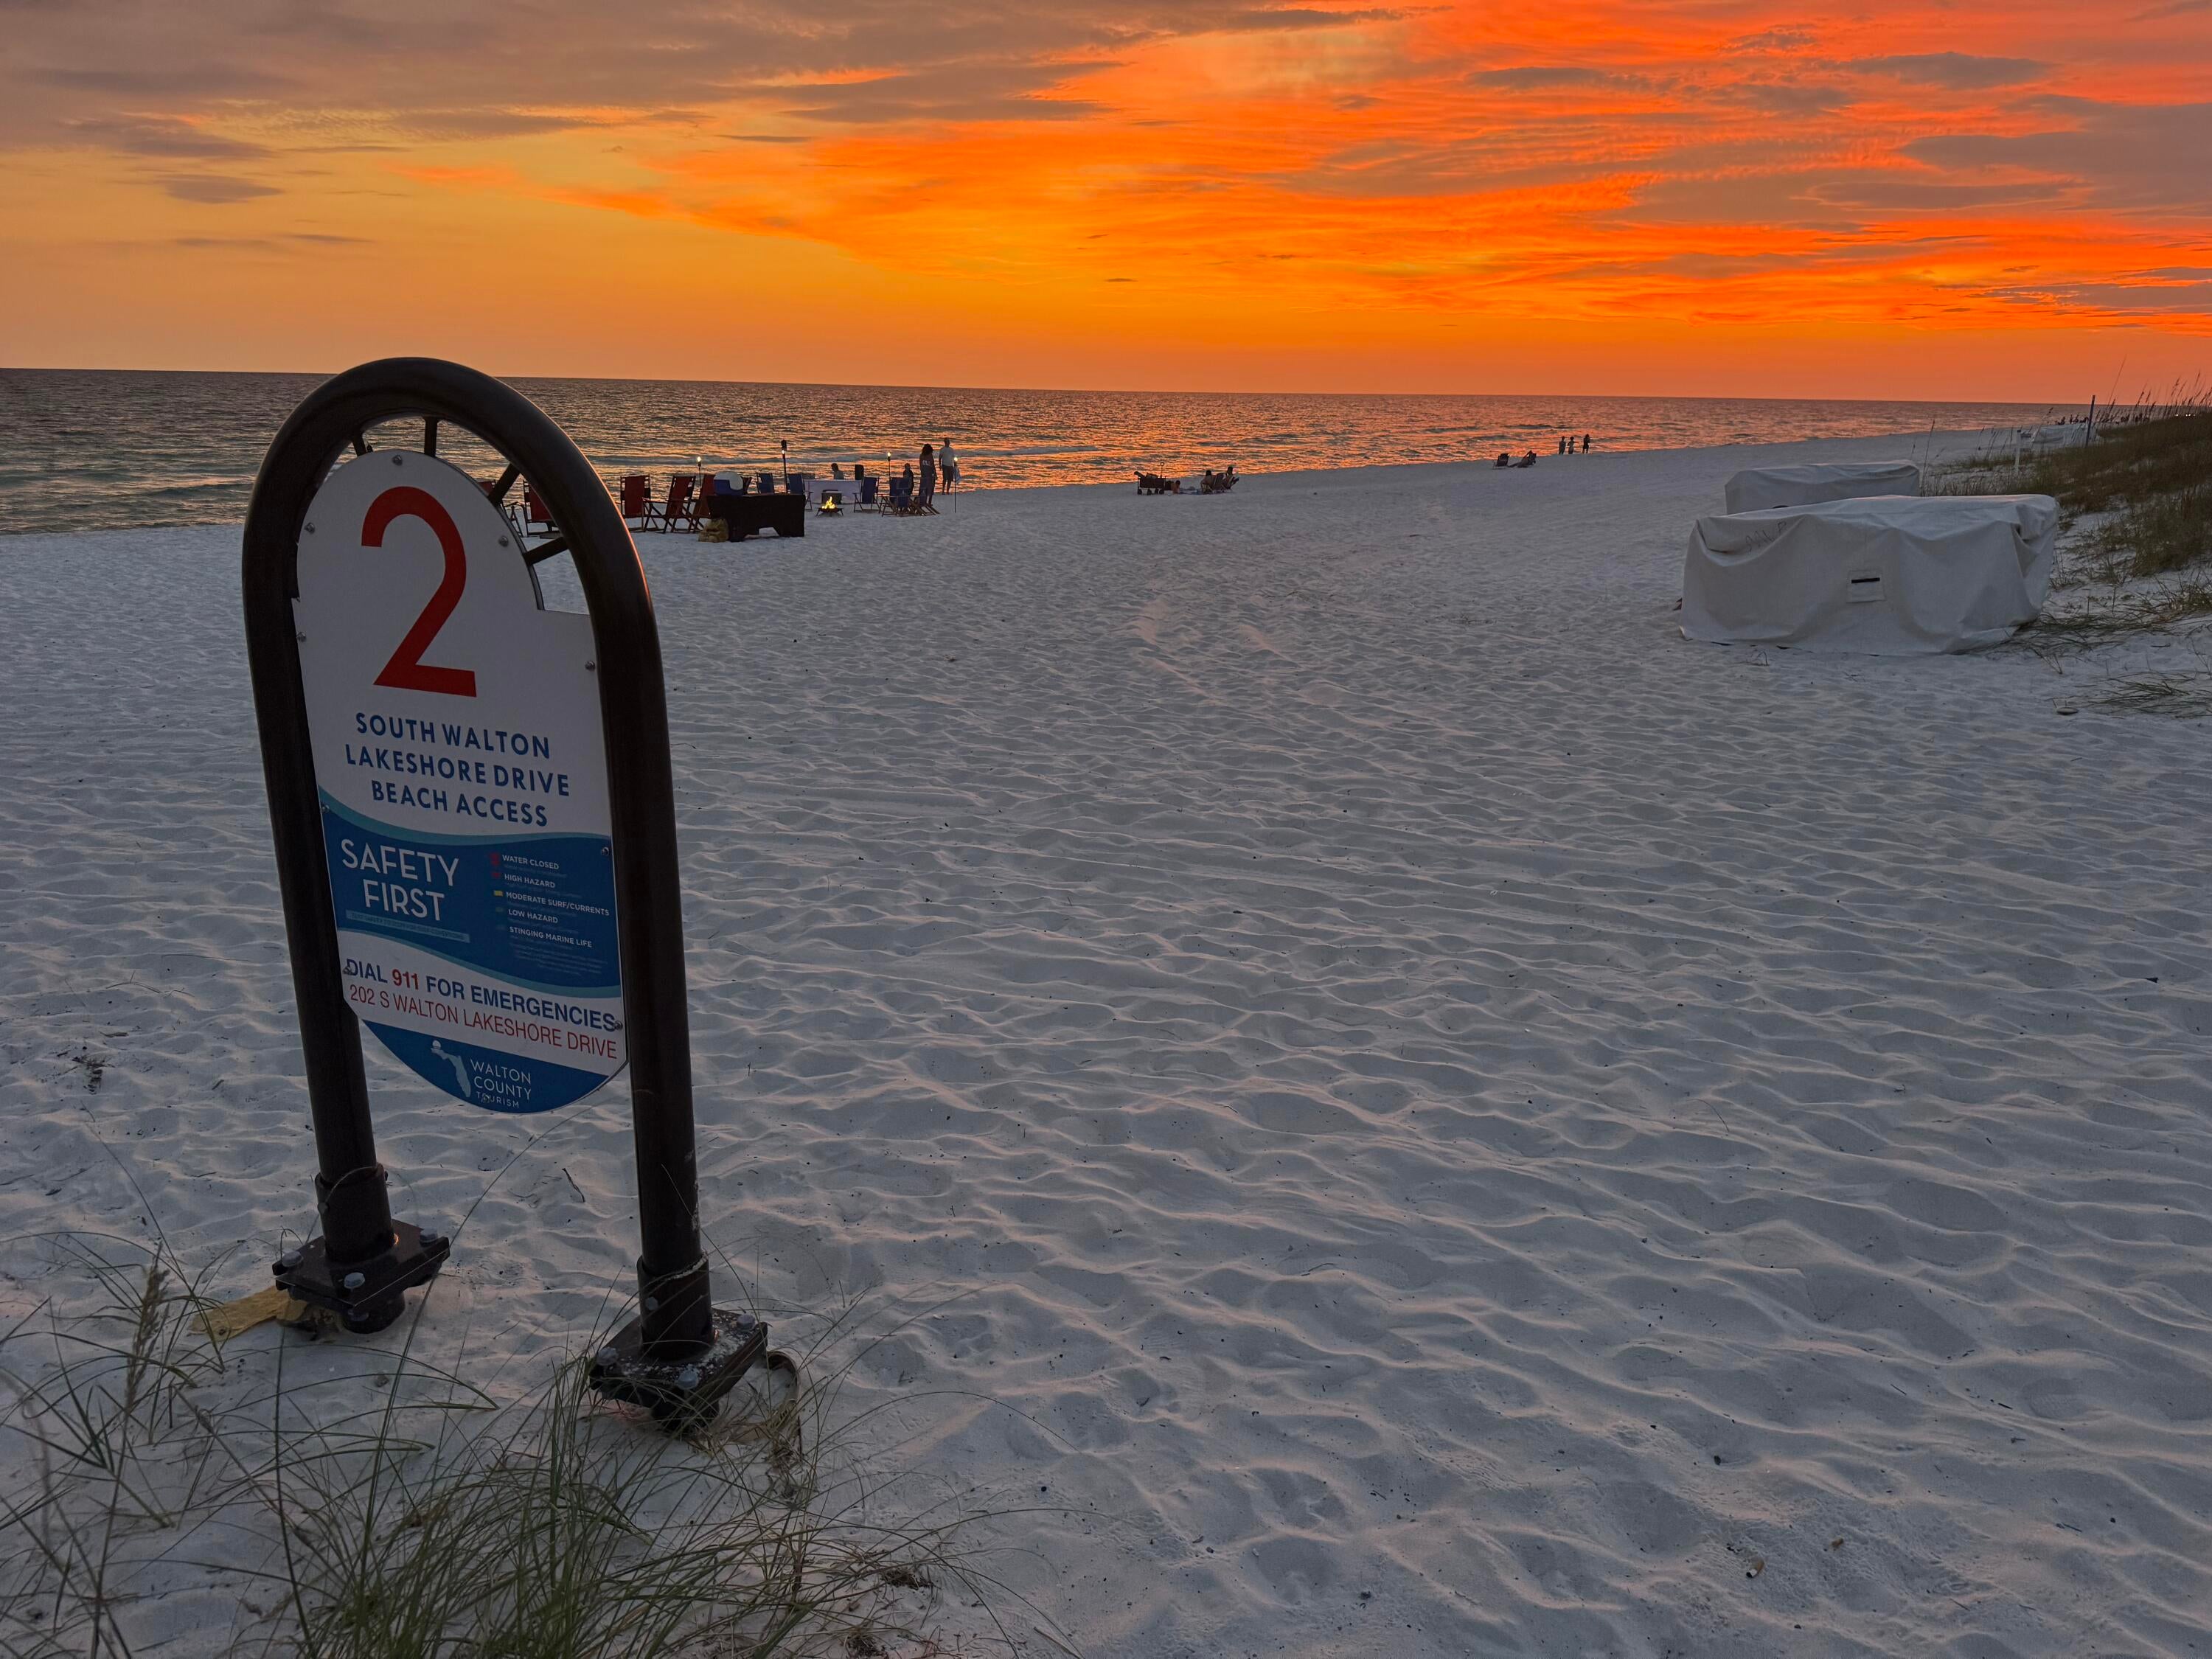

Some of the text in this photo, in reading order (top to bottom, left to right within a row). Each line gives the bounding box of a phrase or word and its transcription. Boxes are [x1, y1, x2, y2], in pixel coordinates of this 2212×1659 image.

[361, 486, 477, 698] 2
[355, 712, 549, 759] SOUTH WALTON
[346, 744, 569, 796] LAKESHORE DRIVE
[372, 780, 548, 827] BEACH ACCESS
[341, 838, 460, 886] SAFETY
[502, 855, 560, 870] WATER CLOSED
[504, 874, 555, 888] HIGH HAZARD
[363, 879, 445, 921] FIRST
[506, 891, 546, 905] MODERATE
[548, 899, 610, 916] SURF/CURRENTS
[508, 908, 525, 917] LOW
[527, 912, 558, 924] HAZARD
[509, 927, 544, 939] STINGING
[546, 933, 574, 945] MARINE
[576, 939, 592, 948] LIFE
[347, 959, 616, 1032] DIAL 911 FOR EMERGENCIES
[350, 984, 617, 1059] 202 S WALTON LAKESHORE DRIVE
[470, 1058, 531, 1085] WALTON
[474, 1076, 531, 1101] COUNTY
[476, 1091, 519, 1109] TURISM
